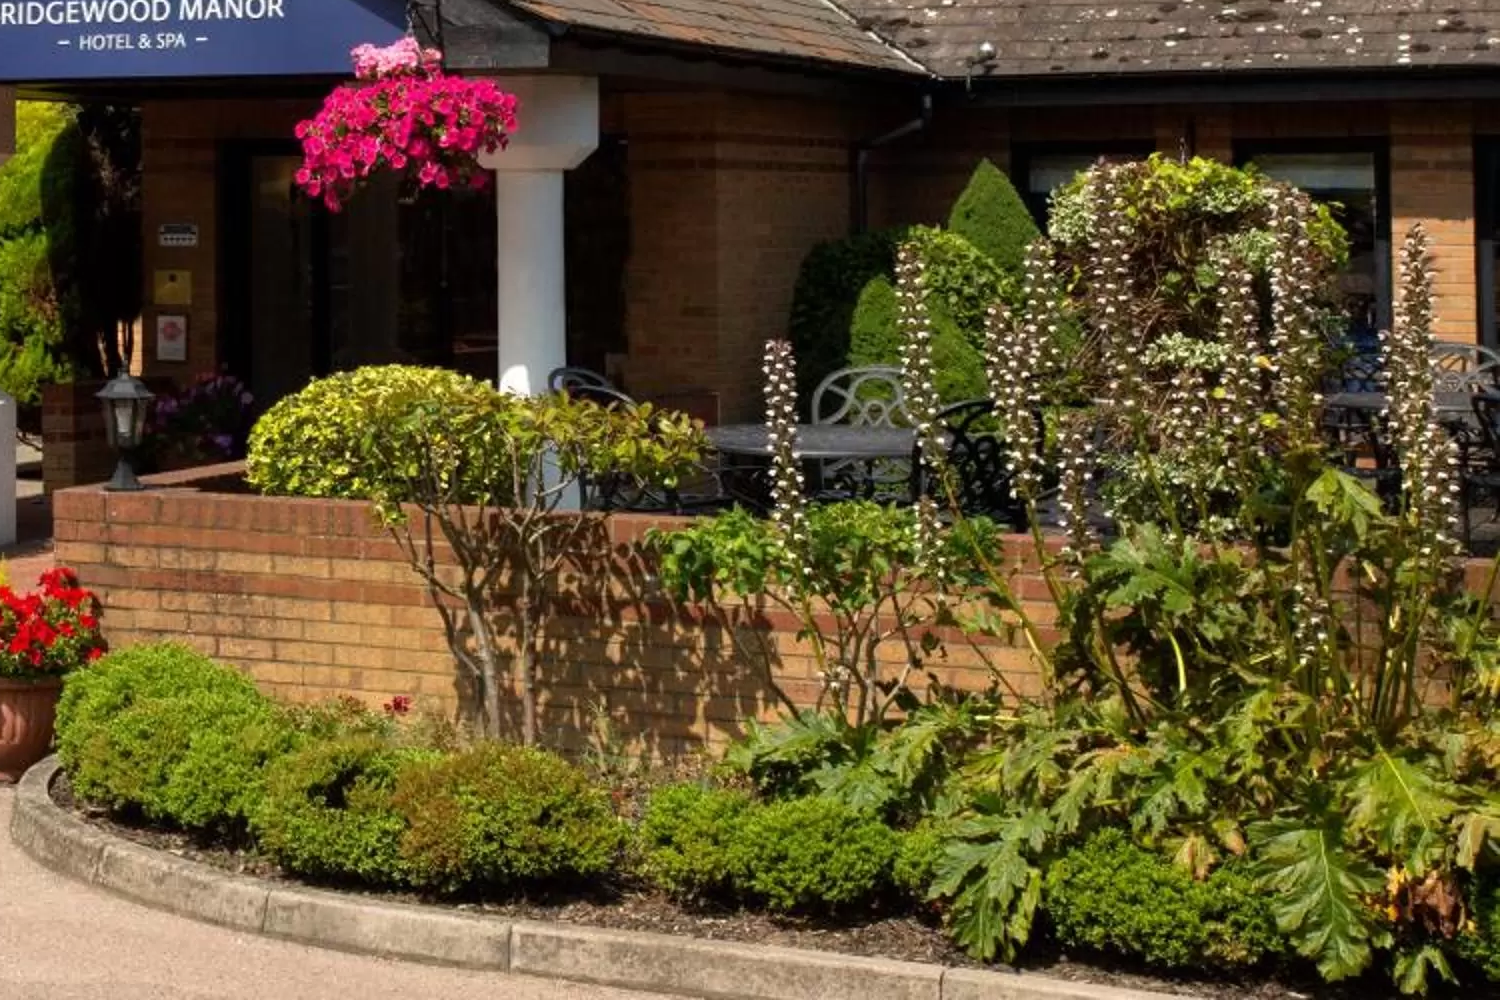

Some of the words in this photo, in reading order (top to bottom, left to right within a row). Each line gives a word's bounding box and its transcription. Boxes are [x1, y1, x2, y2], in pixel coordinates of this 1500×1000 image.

[79, 33, 135, 50] HOTEL
[137, 32, 152, 50] &
[155, 32, 187, 49] SPA
